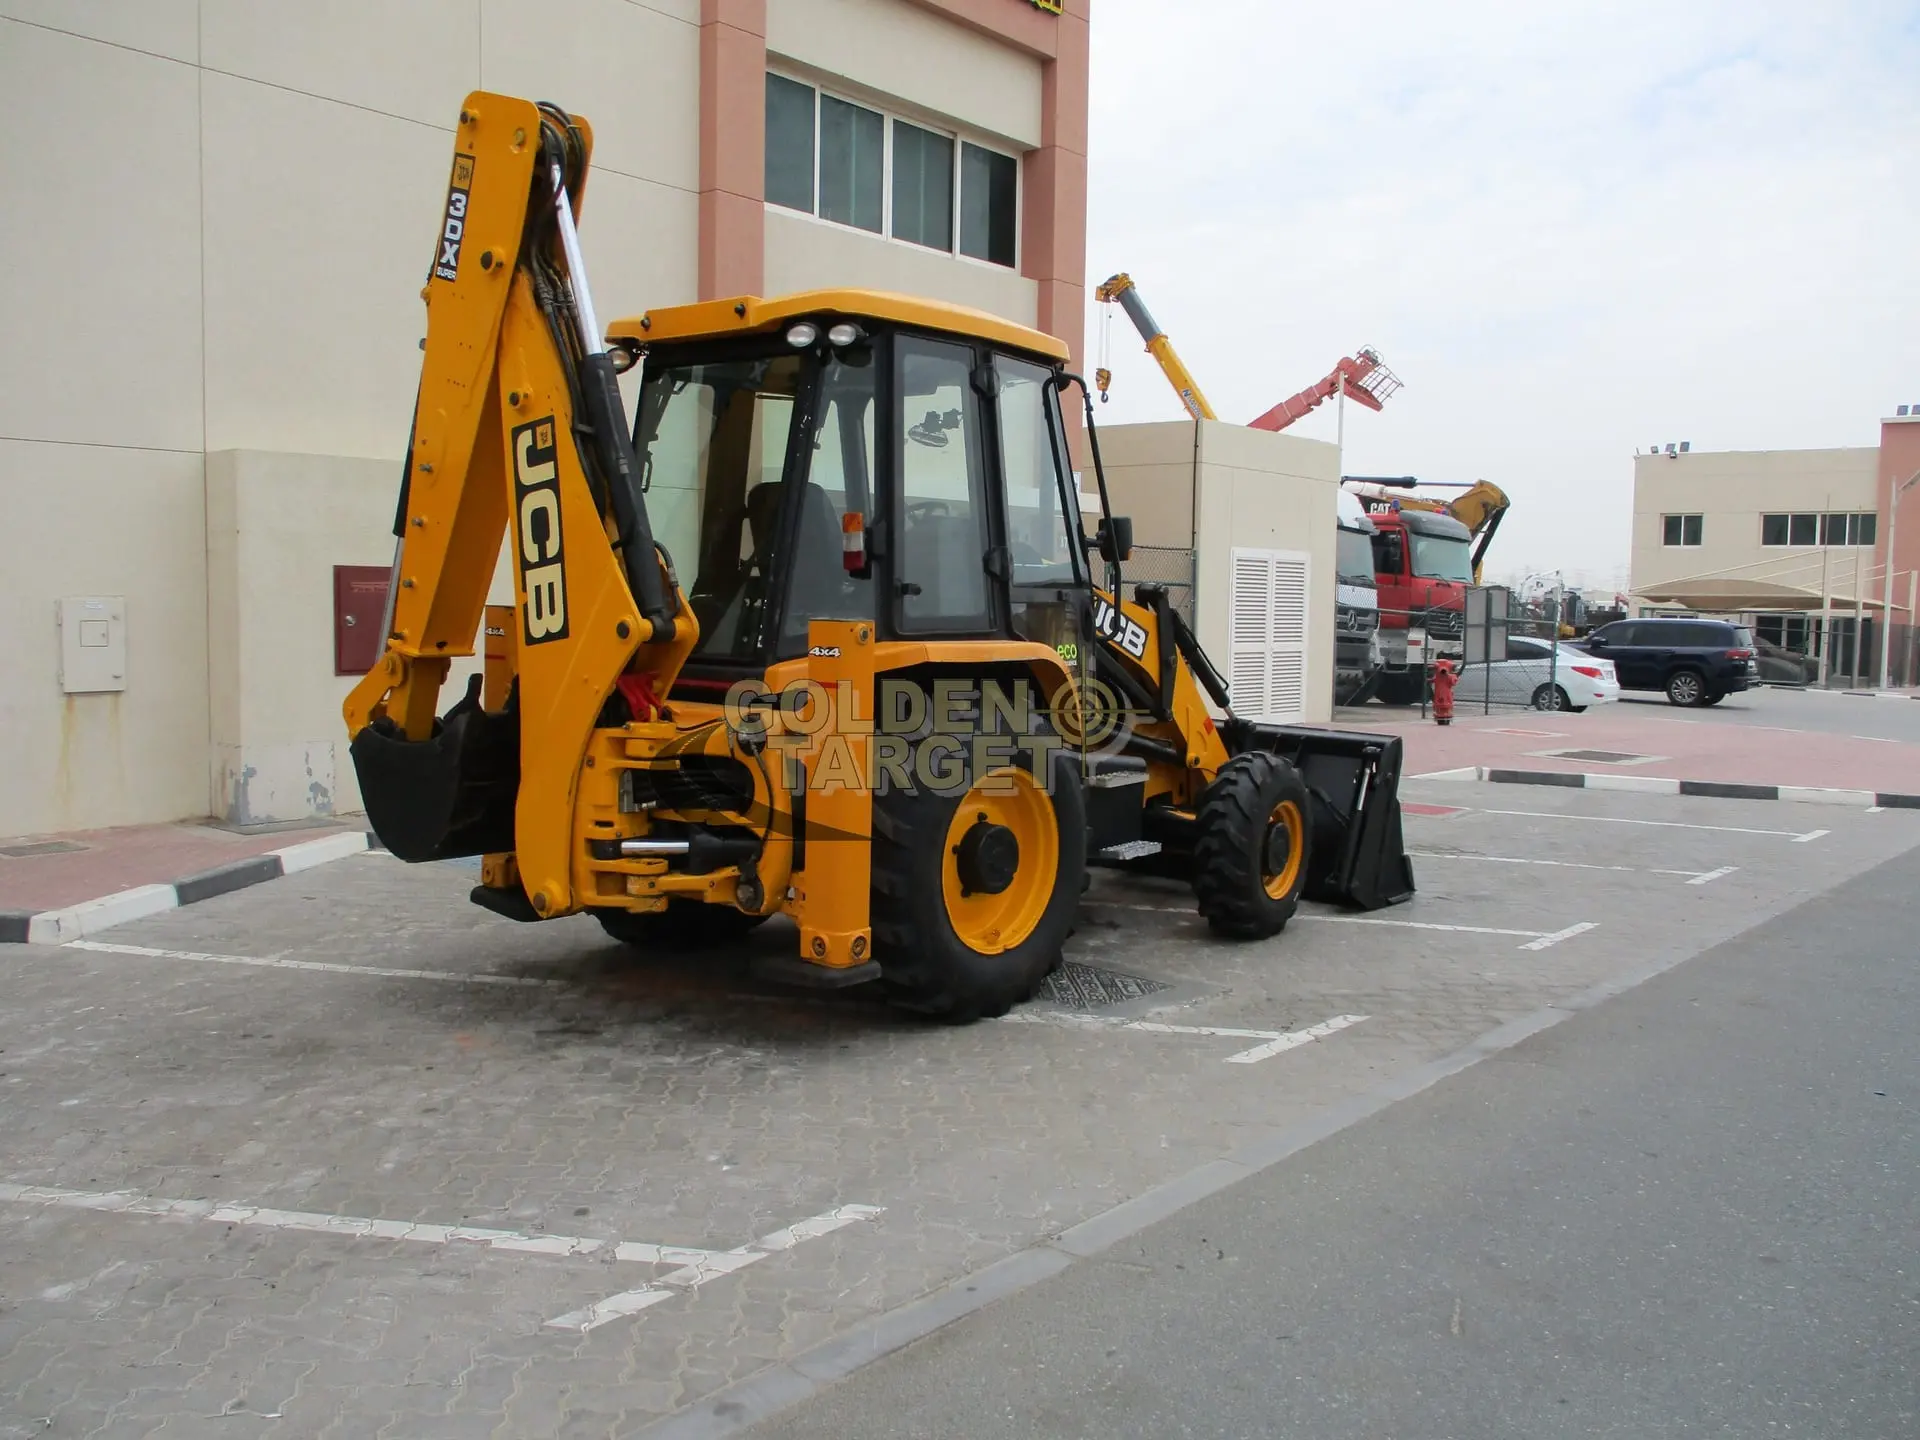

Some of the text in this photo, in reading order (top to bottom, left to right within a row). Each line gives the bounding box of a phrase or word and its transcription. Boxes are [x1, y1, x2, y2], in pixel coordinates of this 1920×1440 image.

[440, 192, 467, 267] 3DX
[516, 429, 565, 639] JCB
[1370, 502, 1391, 515] CAT
